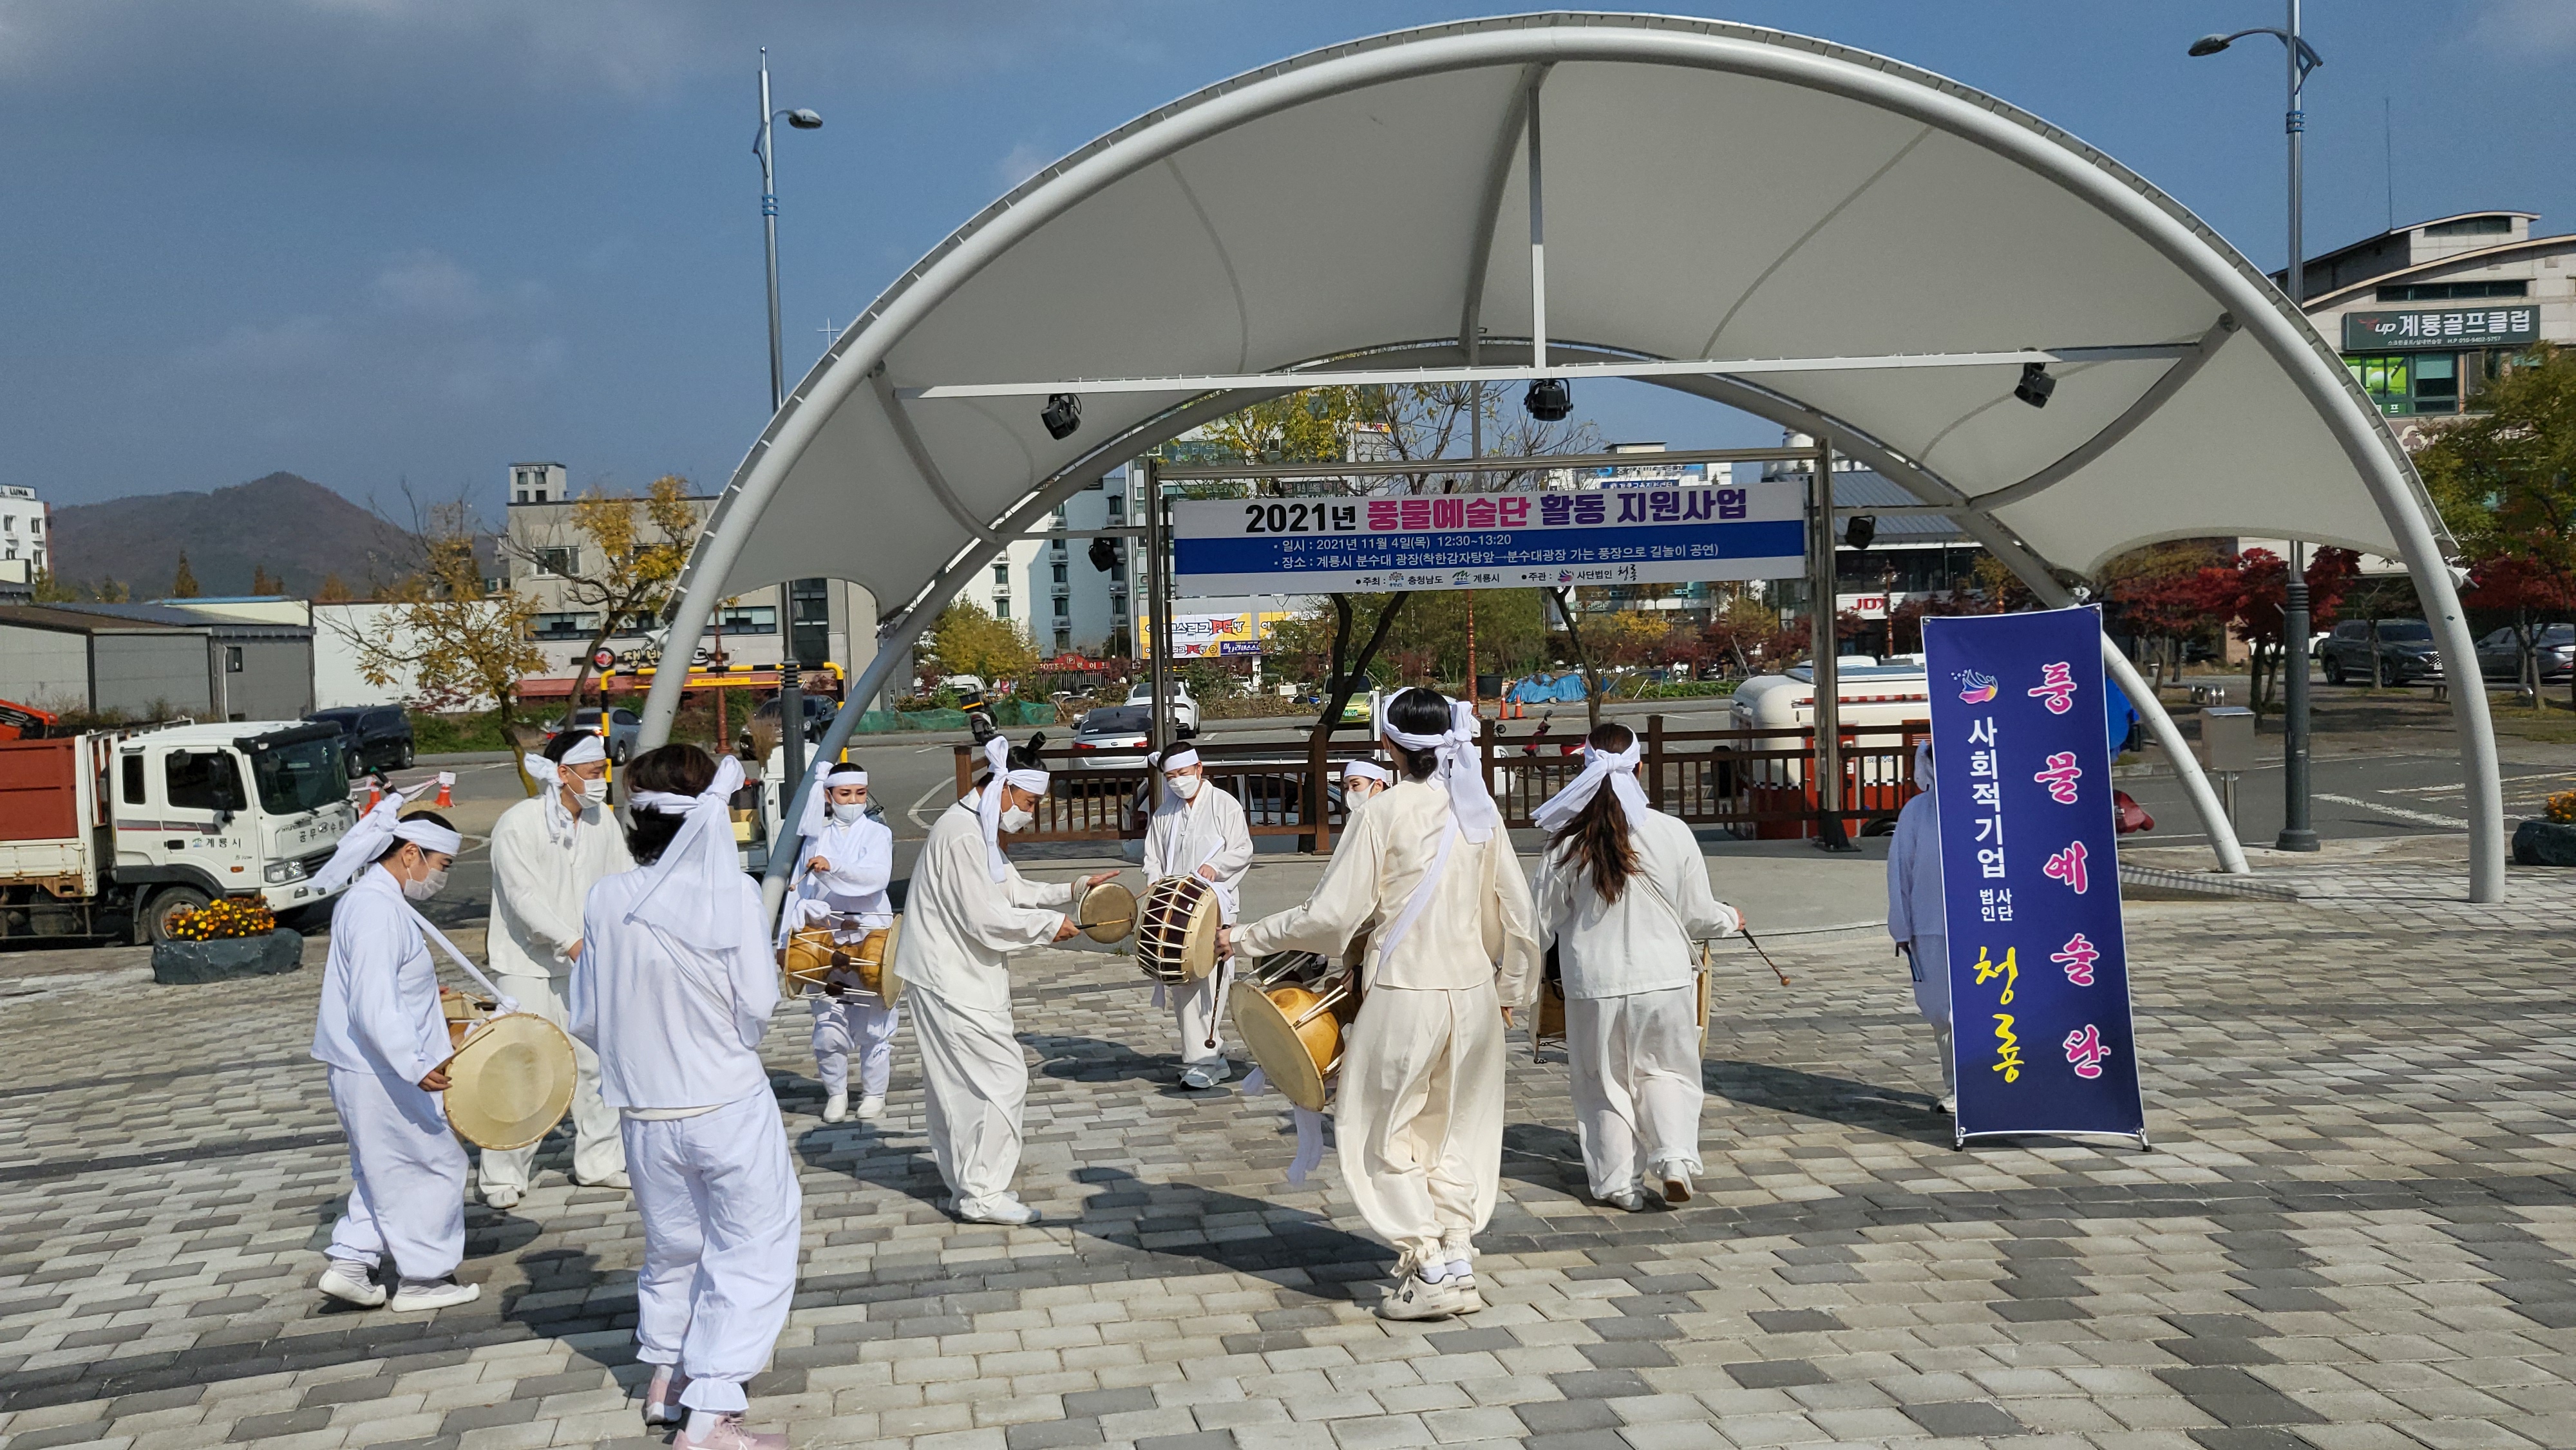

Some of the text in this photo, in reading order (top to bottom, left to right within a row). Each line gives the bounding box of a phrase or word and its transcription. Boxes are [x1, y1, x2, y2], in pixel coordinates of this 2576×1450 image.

[2399, 310, 2530, 337] 계룡골프클럽
[1245, 489, 1747, 533] 2021년 풍물예술단 활동 지원사업
[1282, 540, 1305, 552] 일시
[1317, 538, 1357, 551] 2021년
[1361, 538, 1387, 550] 11월
[1392, 536, 1430, 549] 4일(목)
[1437, 534, 1511, 547] 12:30~13:20
[1282, 556, 1306, 569] 장소
[1316, 555, 1352, 569] 계룡시
[1356, 554, 1391, 567] 분수대
[1570, 549, 1595, 561] 가는
[1597, 547, 1647, 560] 풍장으로
[1650, 545, 1686, 558] 길놀이
[1690, 543, 1719, 557] 공연)
[1362, 576, 1380, 587] 주최
[1407, 574, 1444, 585] 충청남도
[1473, 572, 1501, 583] 계룡시
[1528, 572, 1546, 582] 주관
[1577, 569, 1613, 580] 사단법인
[1967, 716, 2005, 878] 사회적기업
[205, 838, 242, 849] 계룡시
[1973, 946, 2024, 1083] 청룡
